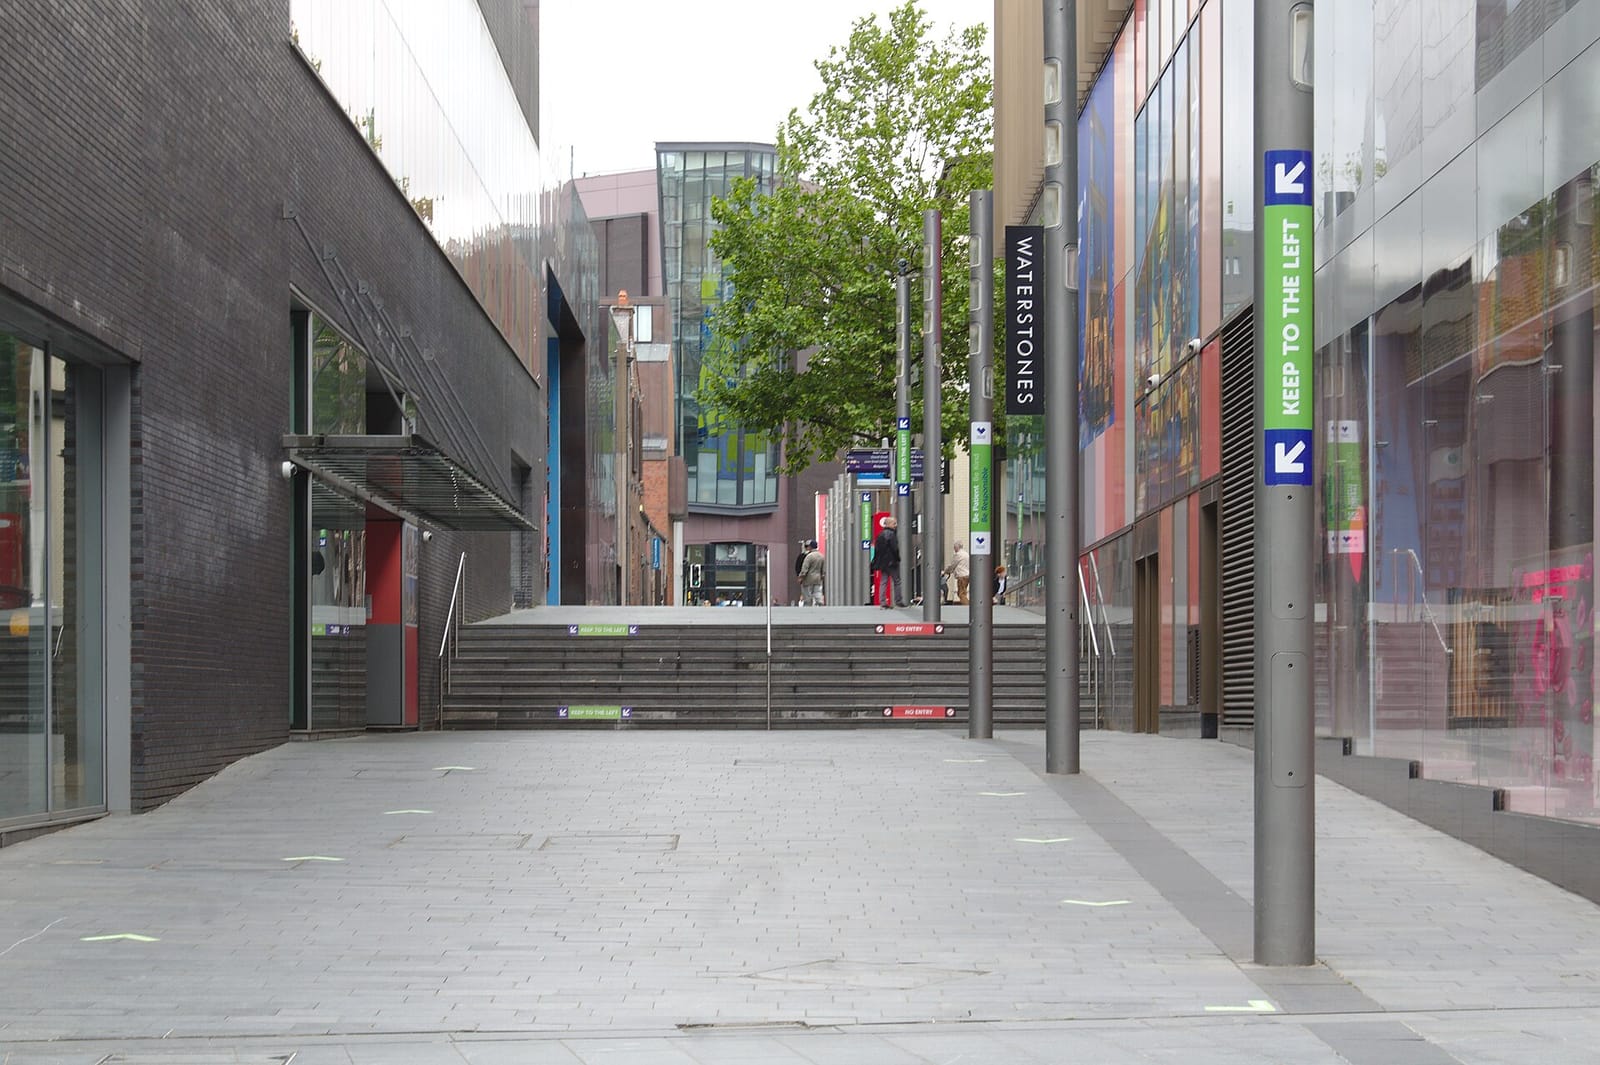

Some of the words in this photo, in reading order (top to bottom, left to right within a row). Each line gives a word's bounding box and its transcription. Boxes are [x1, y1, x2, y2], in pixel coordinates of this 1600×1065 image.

[1282, 218, 1300, 269] LEFT
[1016, 236, 1034, 405] WATERSTONES
[1282, 275, 1300, 319] THE
[1282, 322, 1300, 356] TO
[1282, 361, 1300, 415] KEEP
